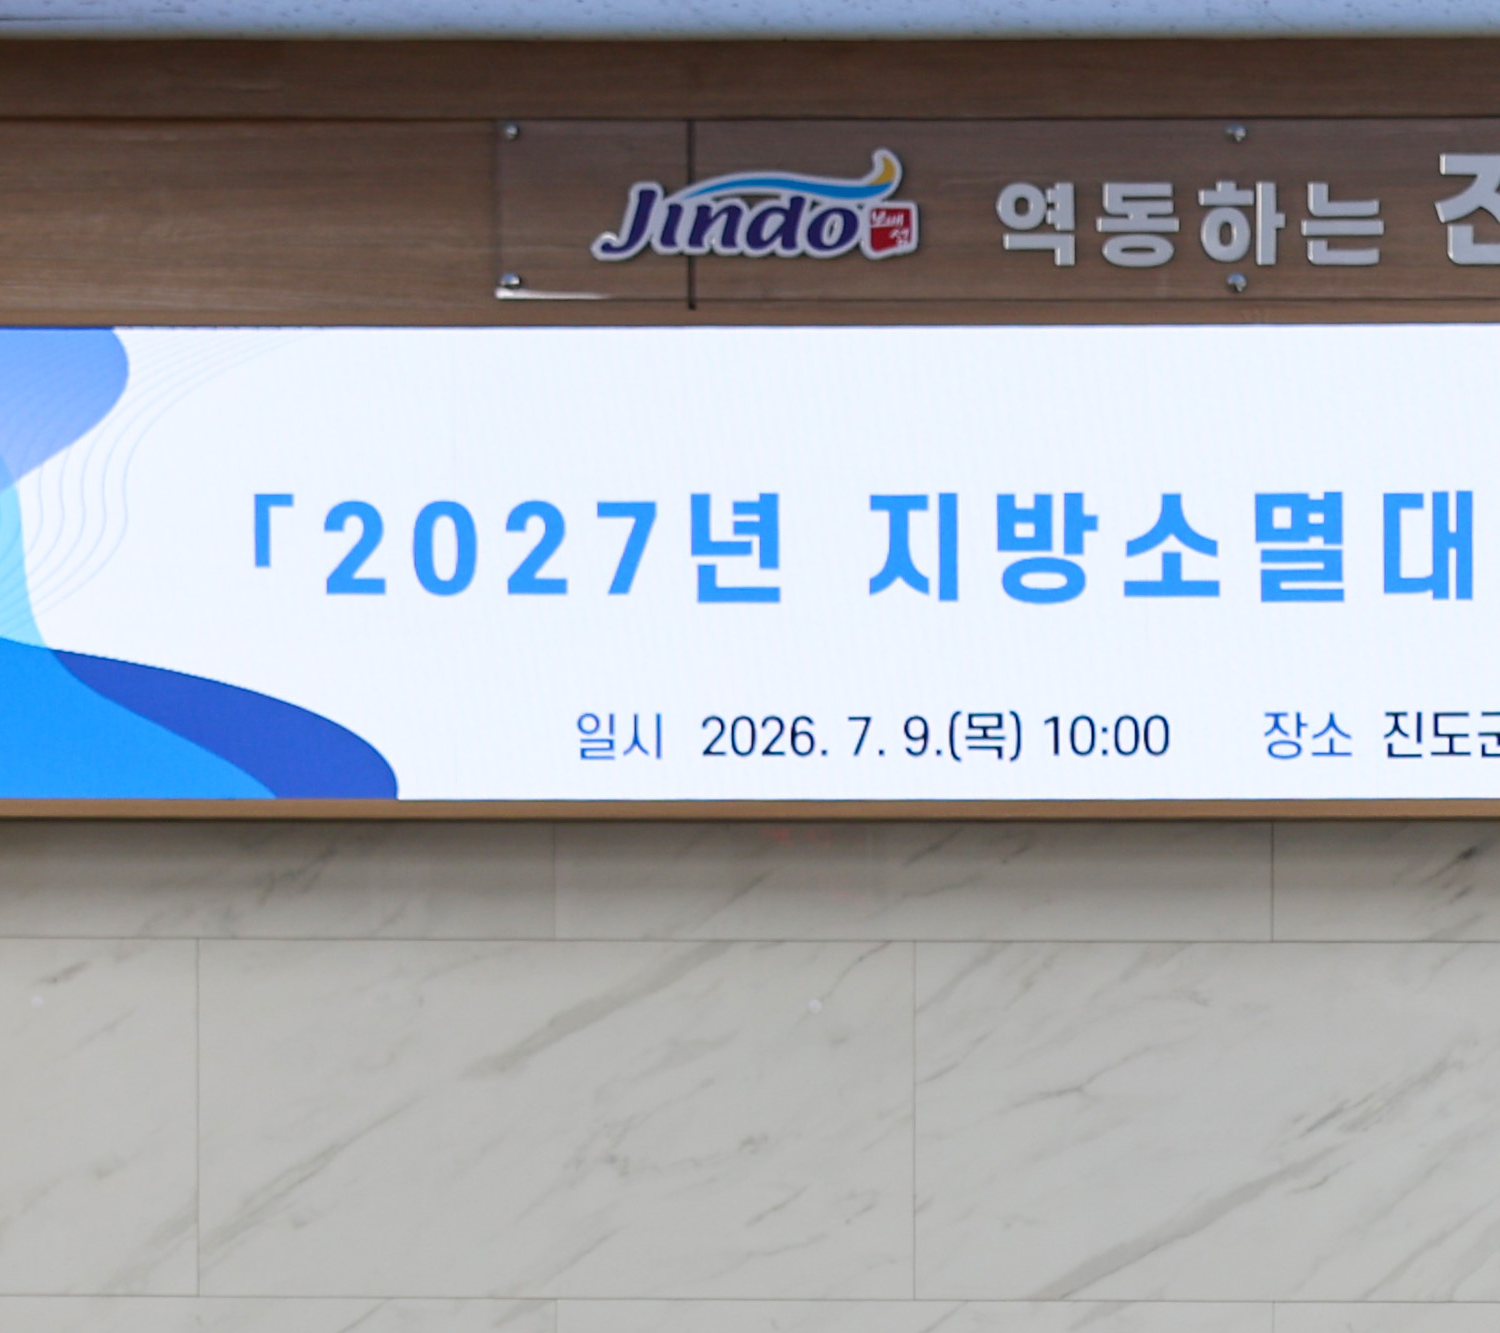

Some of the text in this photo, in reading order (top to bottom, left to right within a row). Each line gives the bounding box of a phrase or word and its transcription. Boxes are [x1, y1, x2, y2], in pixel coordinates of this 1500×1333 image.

[596, 185, 863, 256] Jindo
[996, 180, 1385, 267] 역동하는
[254, 492, 781, 603] 「2027년
[576, 712, 662, 760] 일시
[701, 715, 828, 758] 2026.
[847, 715, 885, 757] 7.
[903, 710, 1022, 762] 9.(목)
[1043, 714, 1170, 757] 10:00
[1264, 711, 1352, 760] 장소
